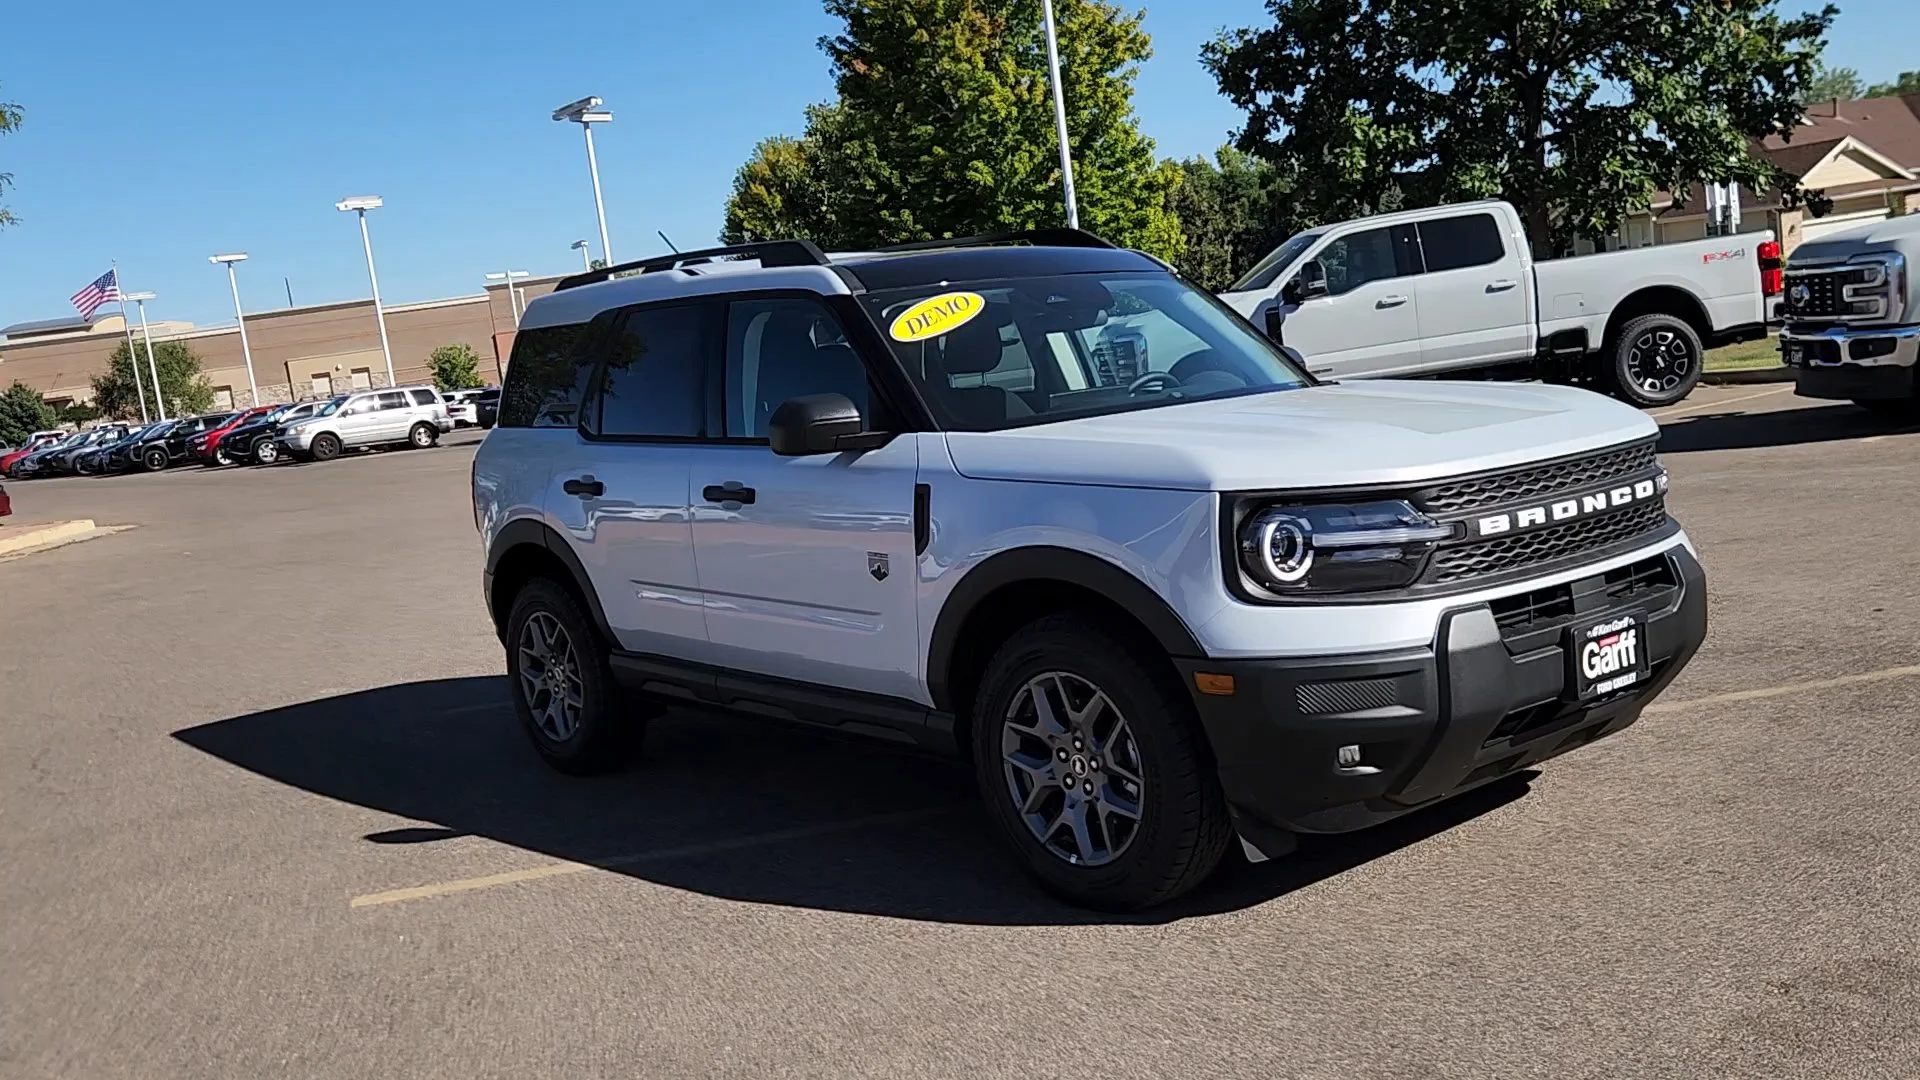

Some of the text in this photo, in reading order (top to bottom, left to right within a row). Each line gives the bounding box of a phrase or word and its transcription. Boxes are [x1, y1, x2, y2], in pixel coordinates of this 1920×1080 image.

[906, 296, 970, 335] DEMO
[1478, 484, 1654, 536] BRONCO
[1582, 629, 1636, 679] Garff
